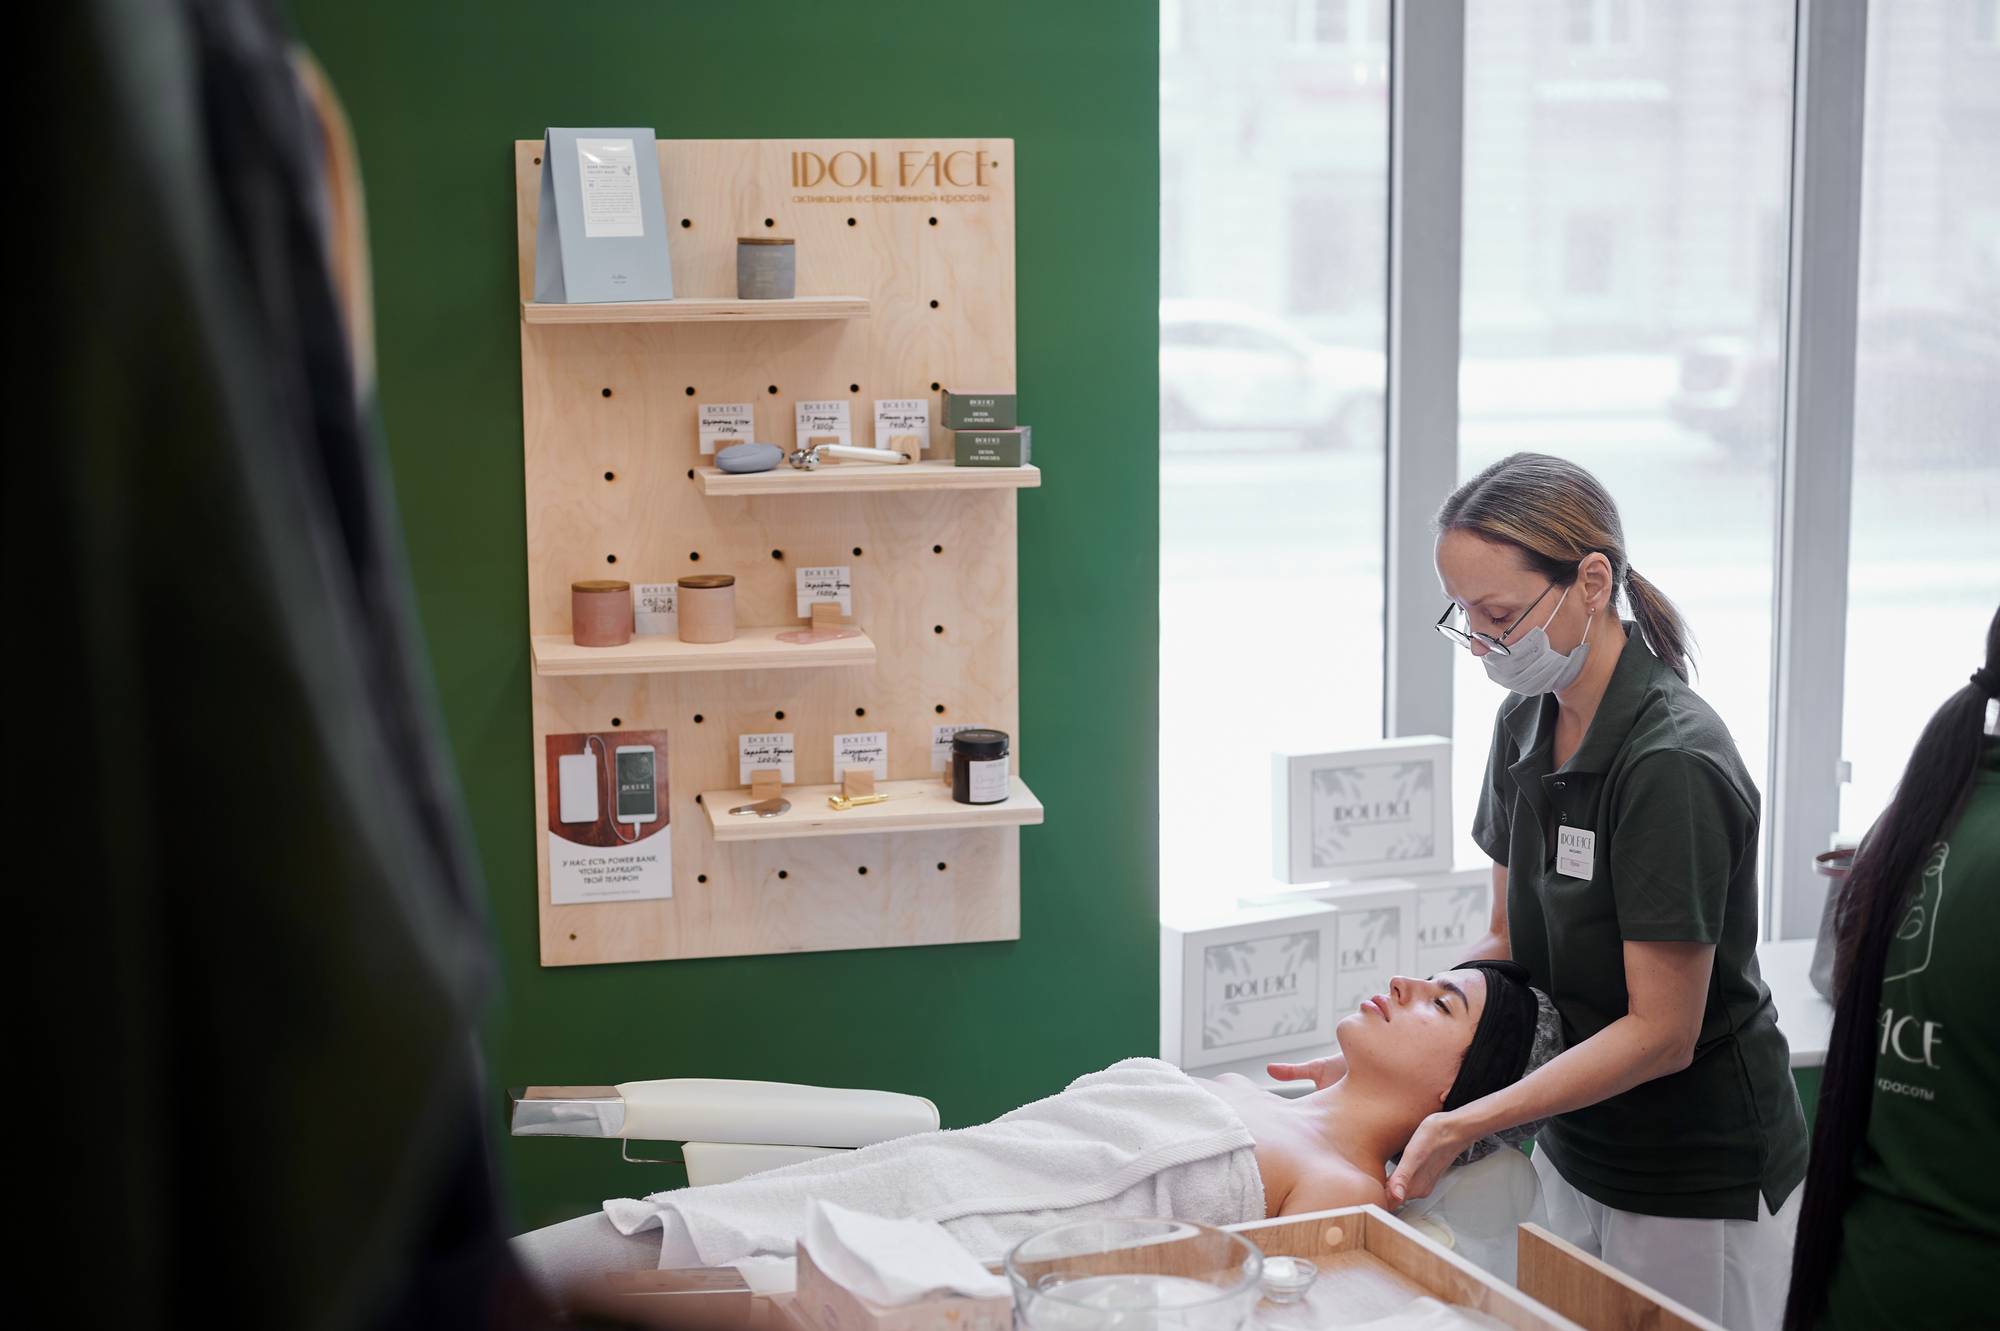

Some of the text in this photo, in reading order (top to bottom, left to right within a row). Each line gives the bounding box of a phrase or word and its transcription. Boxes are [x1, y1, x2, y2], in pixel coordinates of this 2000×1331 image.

[791, 151, 990, 187] IDOL FACE
[940, 193, 990, 205] красоты
[1878, 1007, 1944, 1070] ACE
